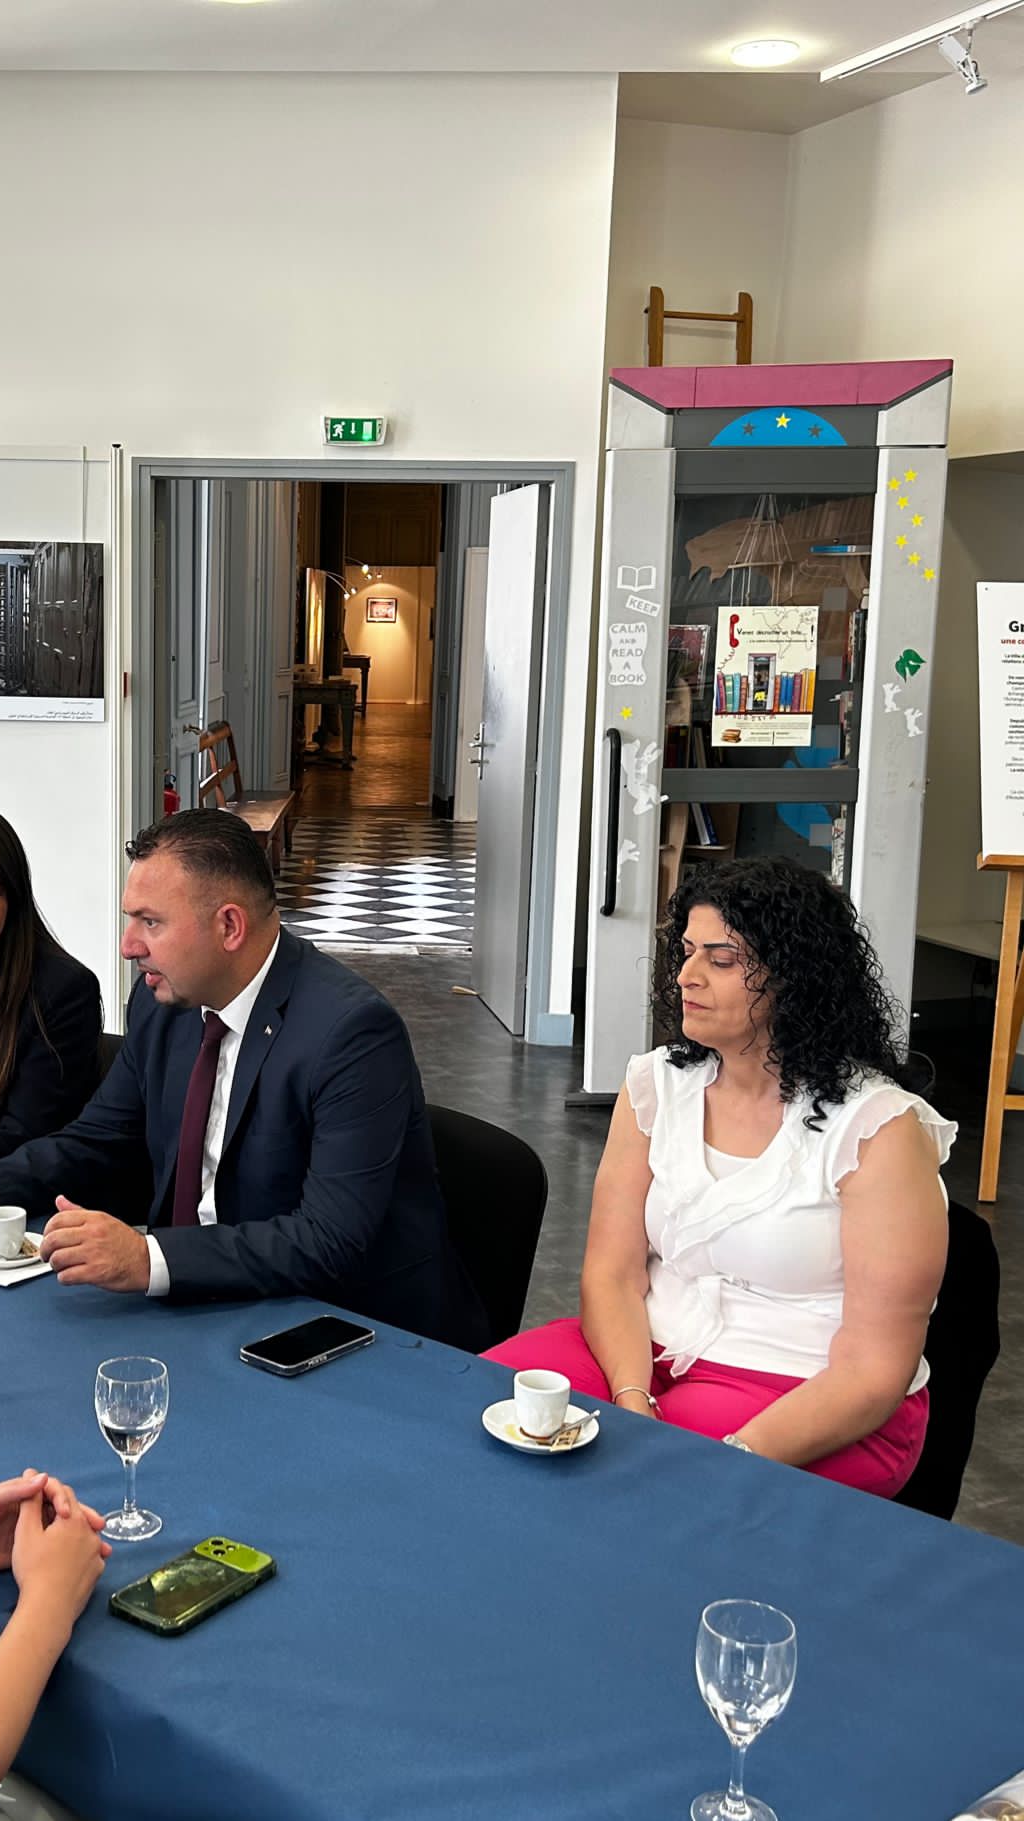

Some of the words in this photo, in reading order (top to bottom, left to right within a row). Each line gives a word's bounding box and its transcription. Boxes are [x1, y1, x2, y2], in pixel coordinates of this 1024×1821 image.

[628, 597, 658, 614] KEEP
[611, 625, 646, 633] CALM
[611, 648, 644, 657] READ
[623, 661, 631, 670] A
[610, 674, 644, 682] BOOK
